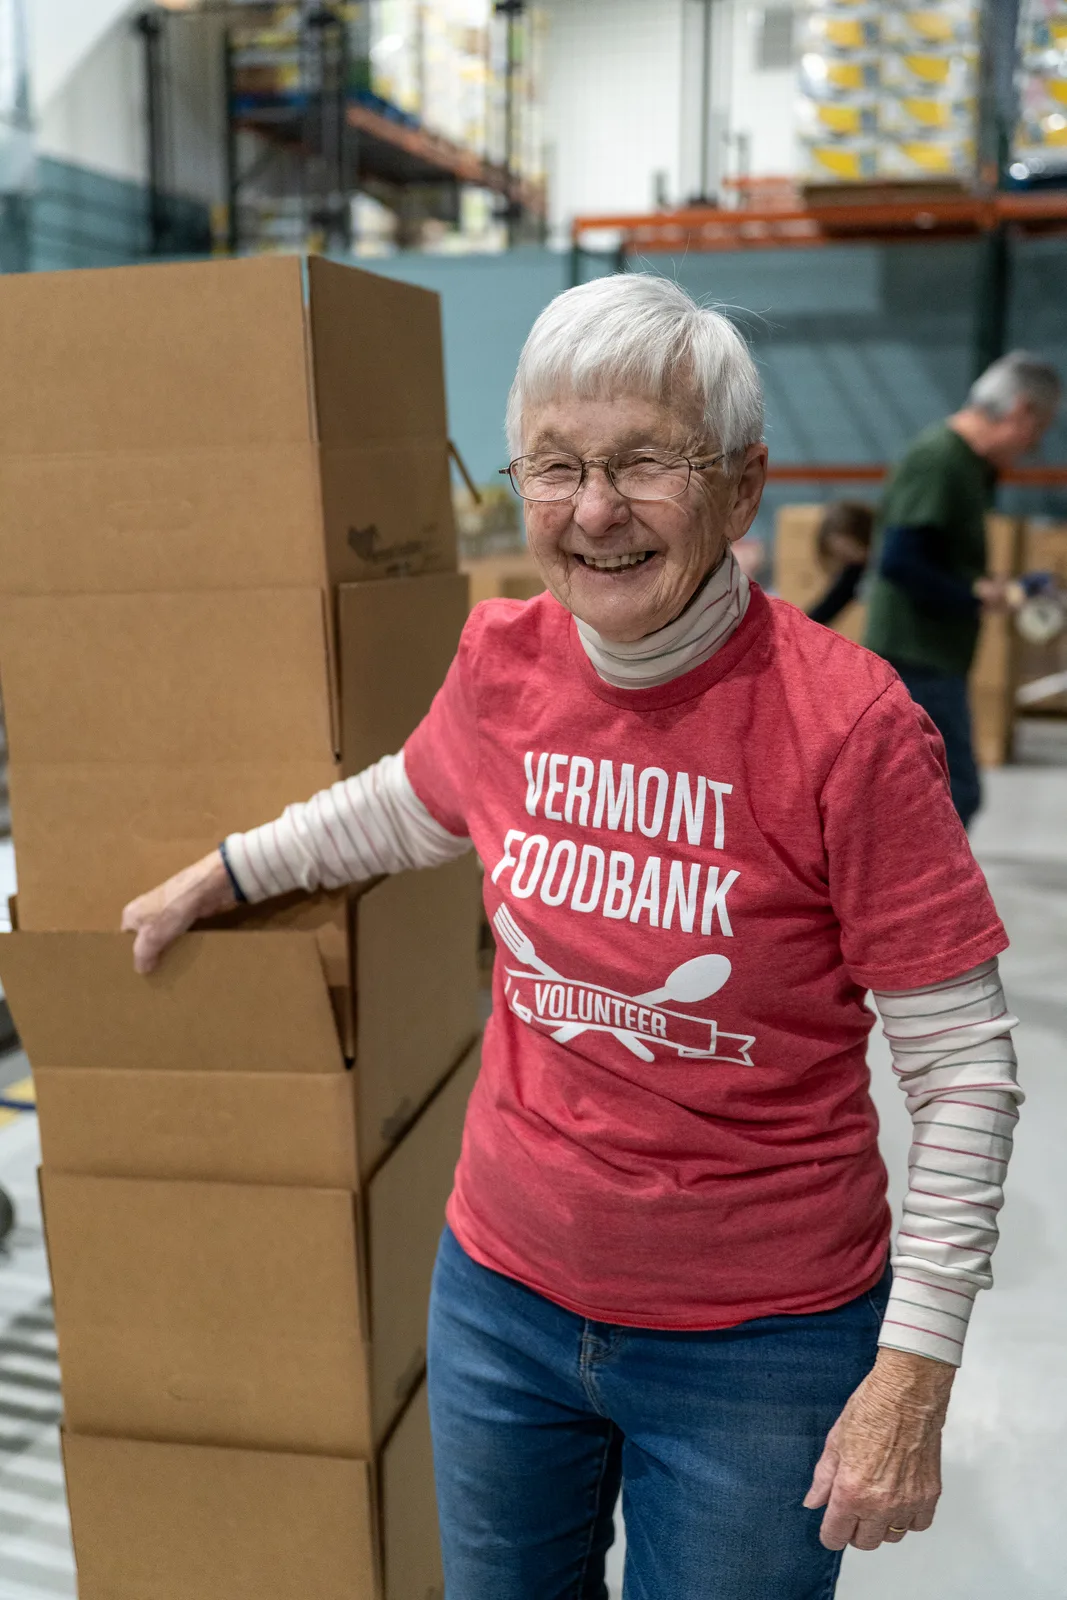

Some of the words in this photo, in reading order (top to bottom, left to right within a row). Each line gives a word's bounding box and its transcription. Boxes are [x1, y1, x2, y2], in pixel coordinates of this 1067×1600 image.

[524, 751, 734, 850] VERMONT
[491, 829, 741, 937] FOODBANK
[534, 983, 668, 1038] VOLUNTEER
